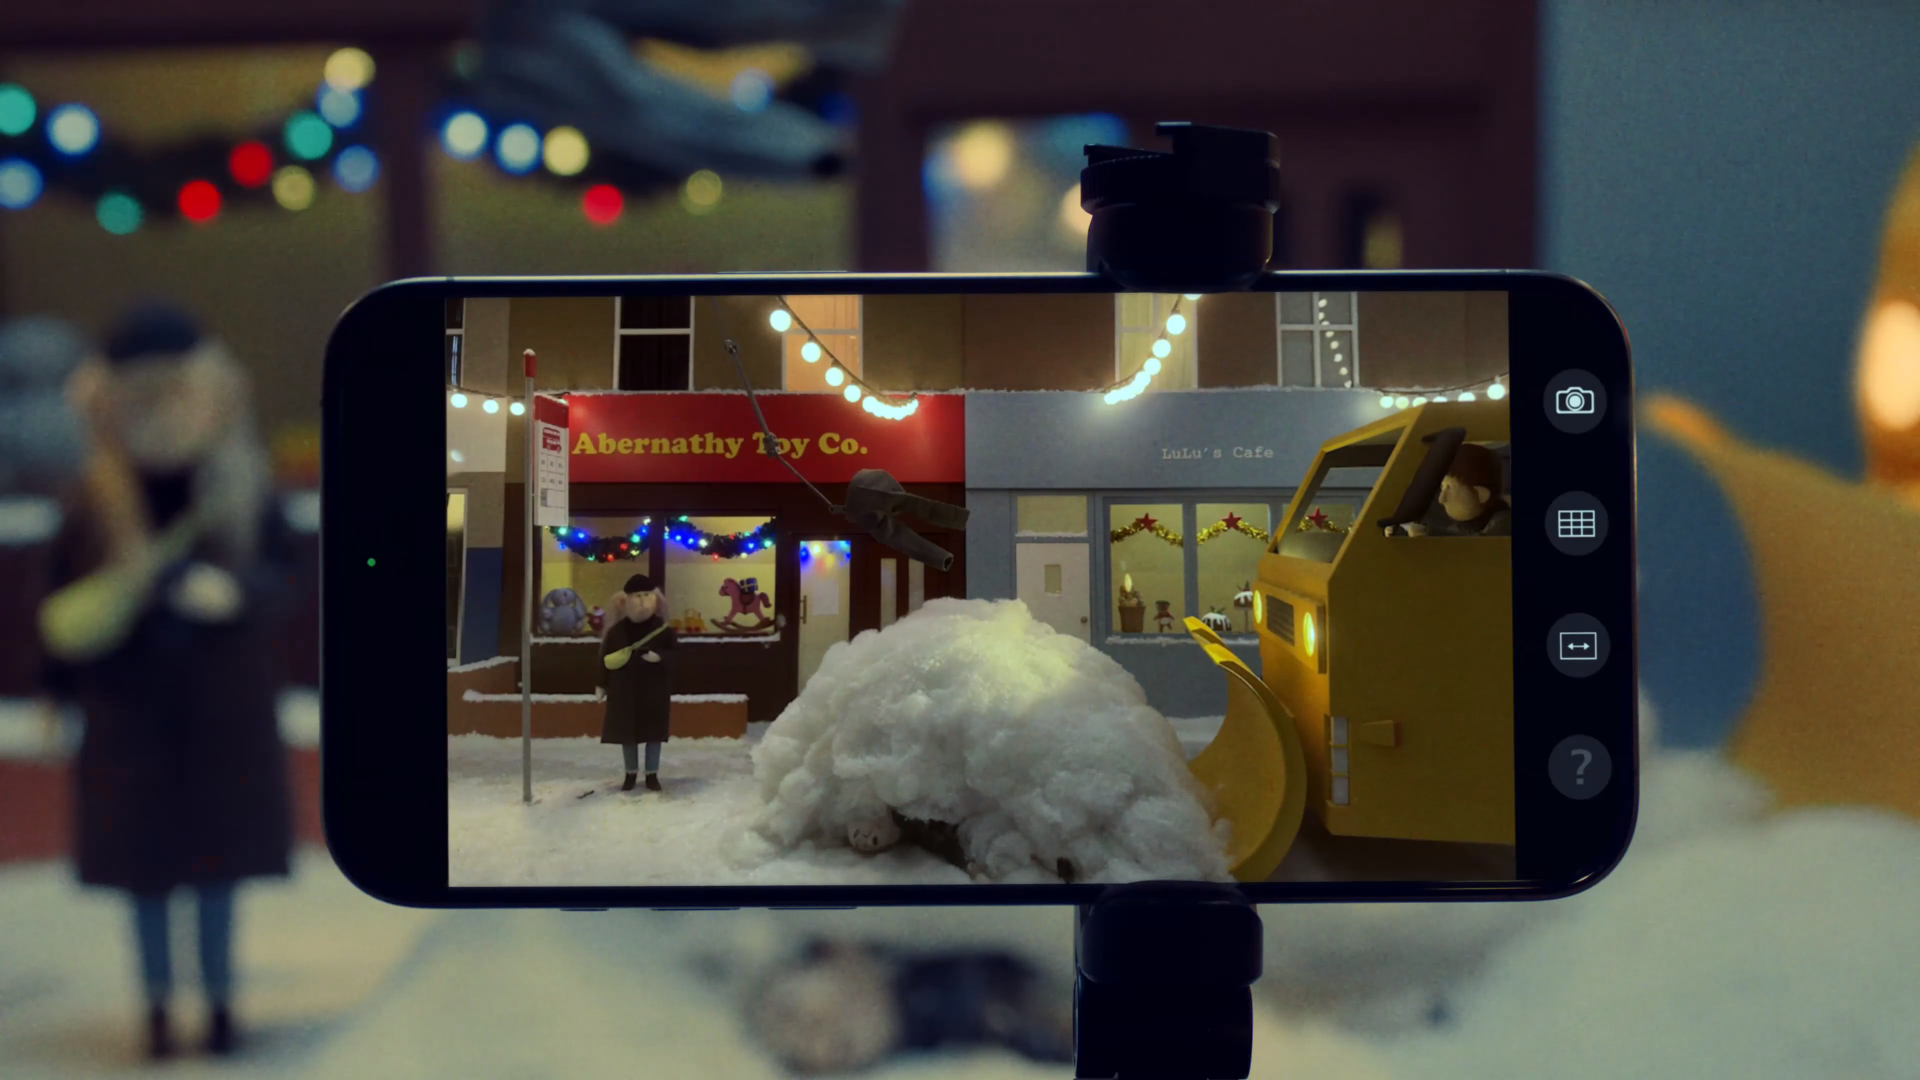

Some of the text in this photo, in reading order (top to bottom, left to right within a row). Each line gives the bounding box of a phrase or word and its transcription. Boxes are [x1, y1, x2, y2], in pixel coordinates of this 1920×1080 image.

[572, 432, 744, 459] Abernathy
[818, 432, 868, 454] Co.
[1161, 446, 1274, 459] LuLu's Cafe
[1570, 748, 1593, 786] ?
